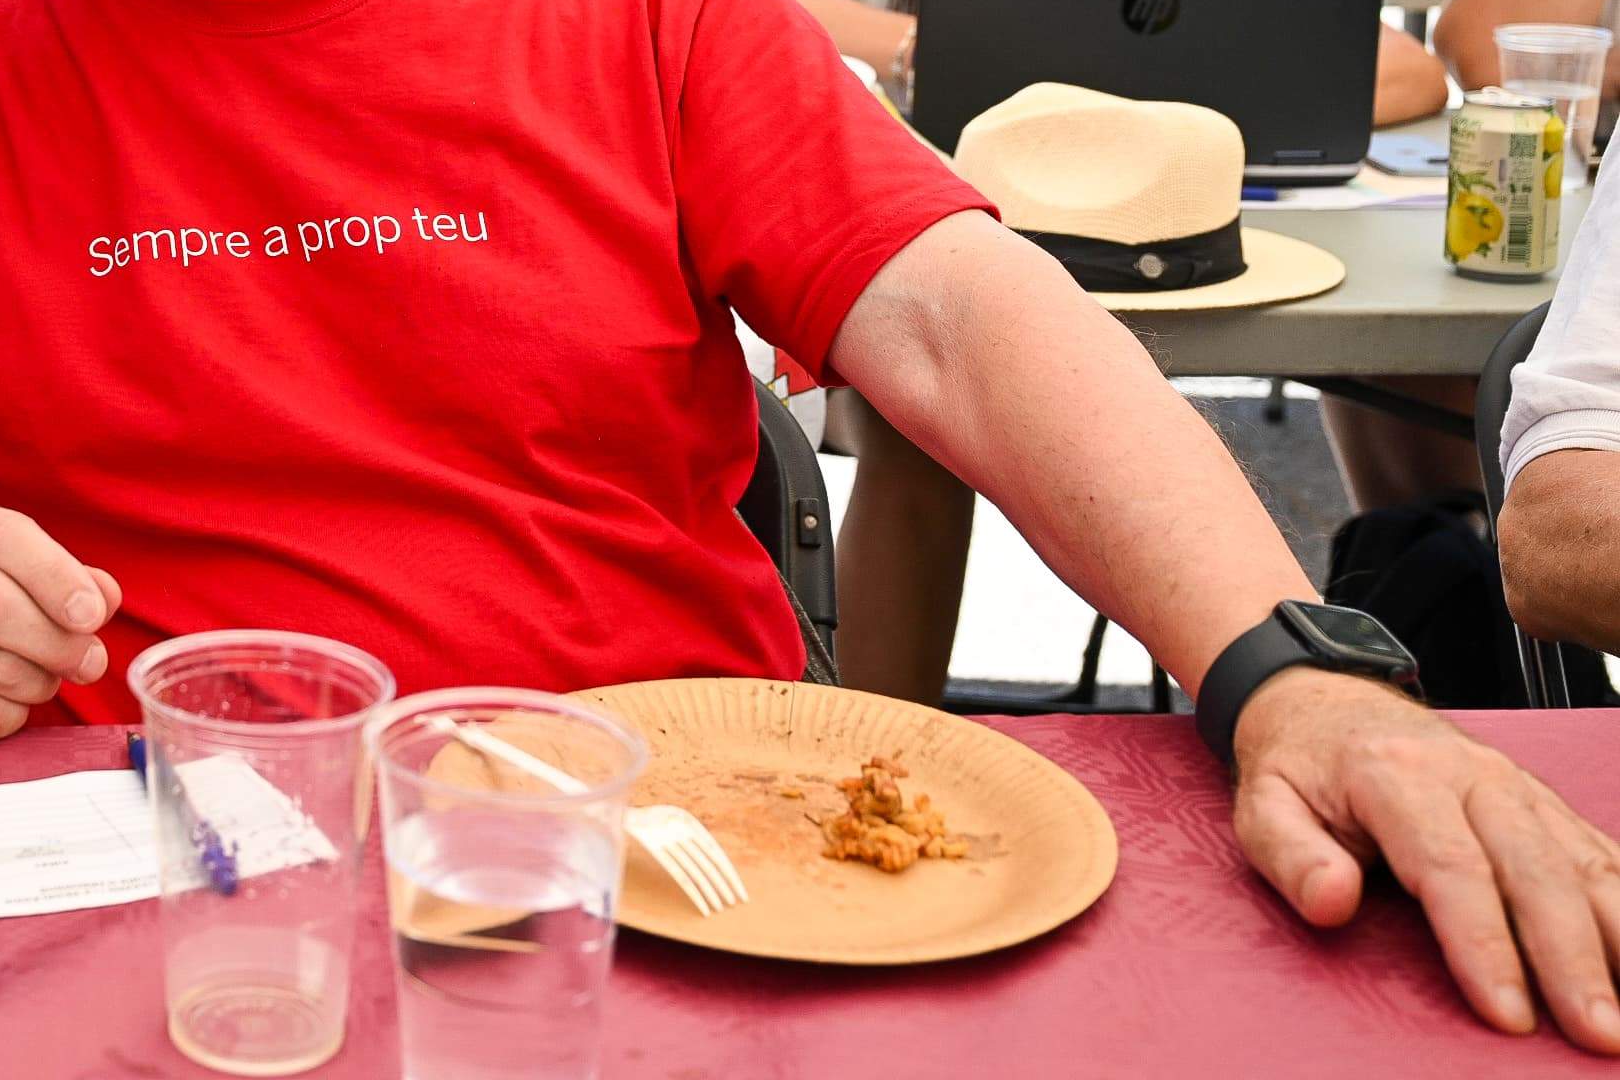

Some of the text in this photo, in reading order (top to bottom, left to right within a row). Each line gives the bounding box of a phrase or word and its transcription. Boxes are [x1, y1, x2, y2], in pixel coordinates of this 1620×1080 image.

[88, 207, 488, 277] Sempre a prop teu
